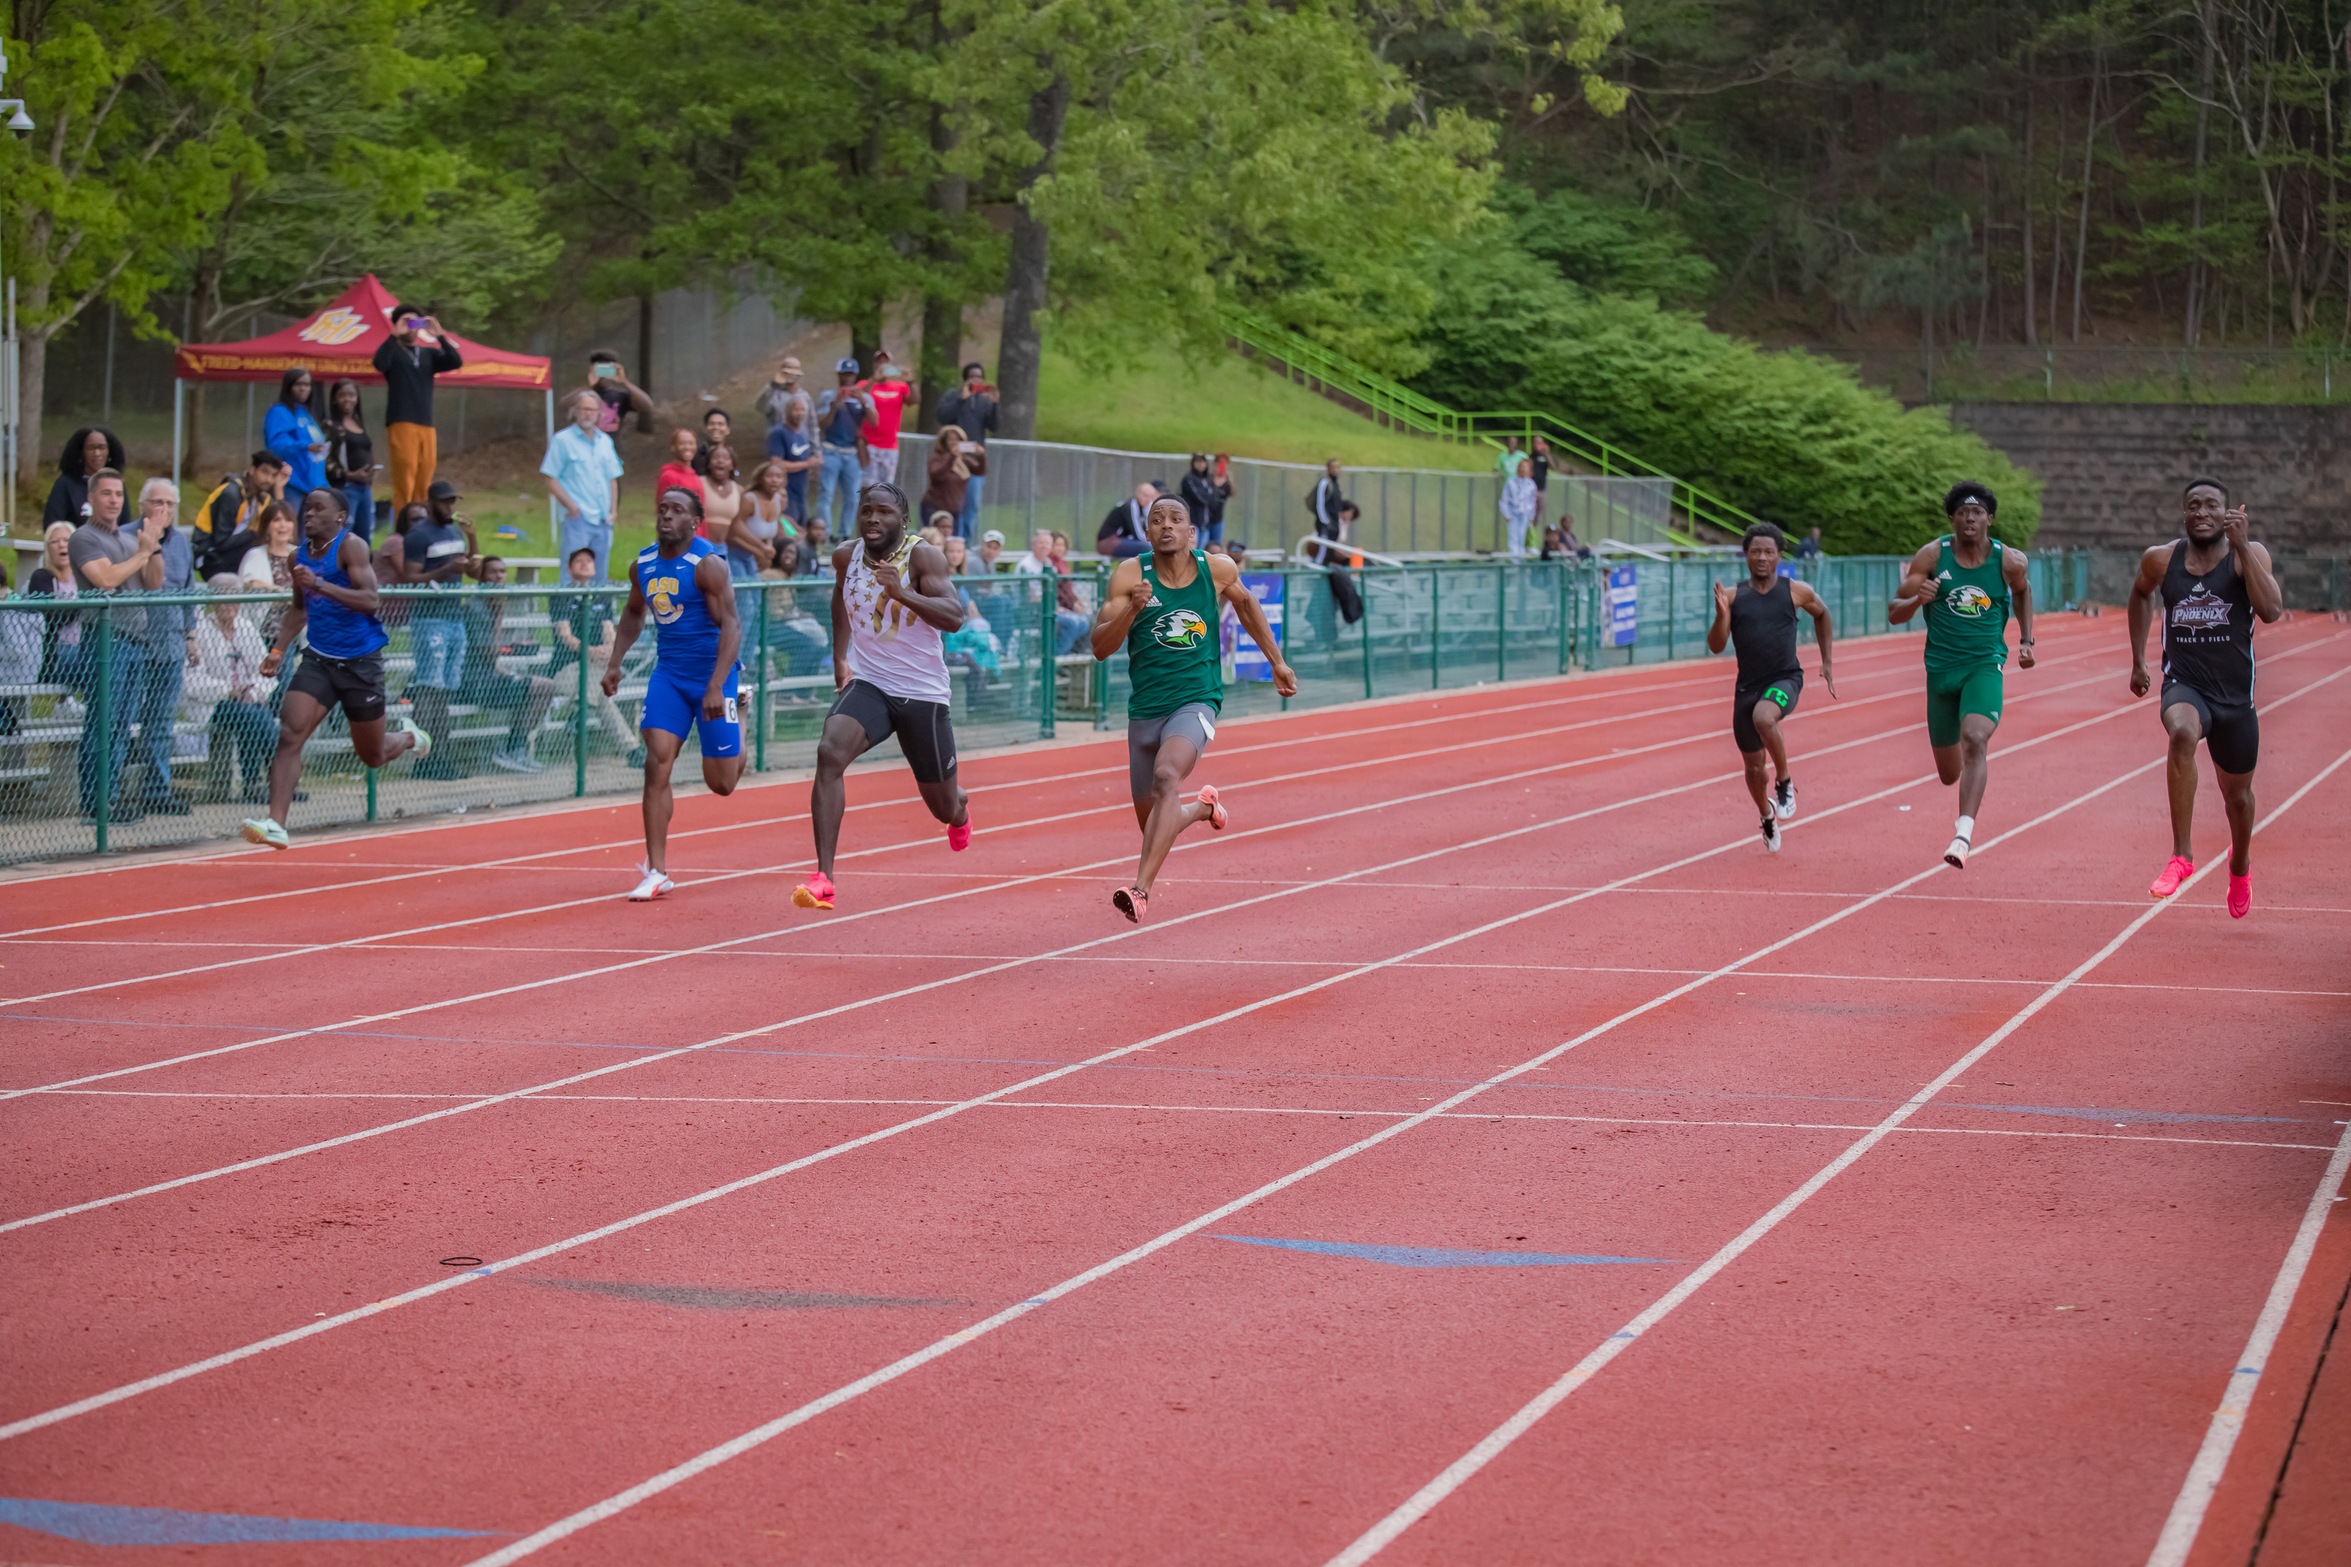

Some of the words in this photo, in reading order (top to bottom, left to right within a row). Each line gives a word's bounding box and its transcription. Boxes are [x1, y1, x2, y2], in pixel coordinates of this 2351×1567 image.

[646, 577, 679, 597] ASU
[2174, 608, 2225, 622] PHOENIX
[728, 700, 737, 721] 6
